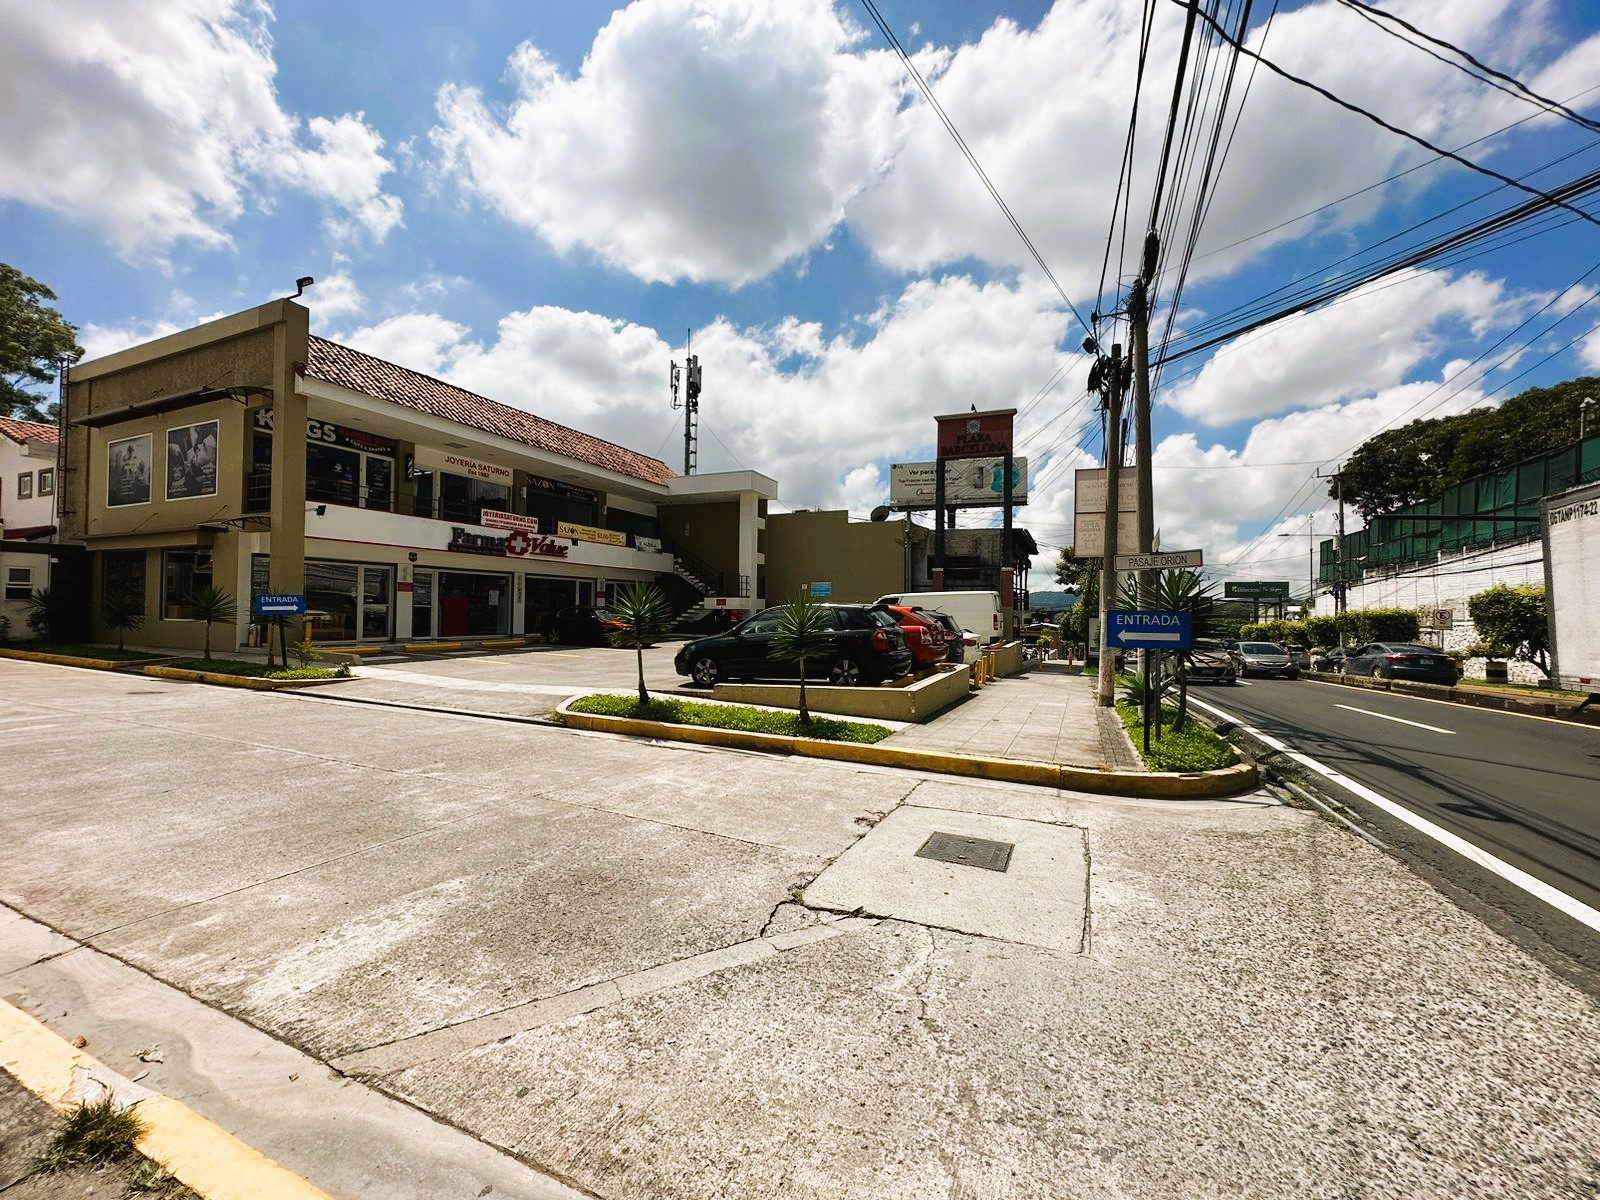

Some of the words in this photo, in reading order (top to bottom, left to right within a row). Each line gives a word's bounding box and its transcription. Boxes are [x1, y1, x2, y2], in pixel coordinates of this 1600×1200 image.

[255, 408, 336, 441] KGS
[957, 433, 992, 444] PLAZA
[941, 442, 1008, 455] BARCELONA
[478, 463, 510, 477] SATURNO
[451, 526, 506, 546] Farma
[1128, 556, 1159, 567] PASAJE
[1160, 555, 1188, 566] ORION
[1116, 614, 1181, 626] ENTRADA
